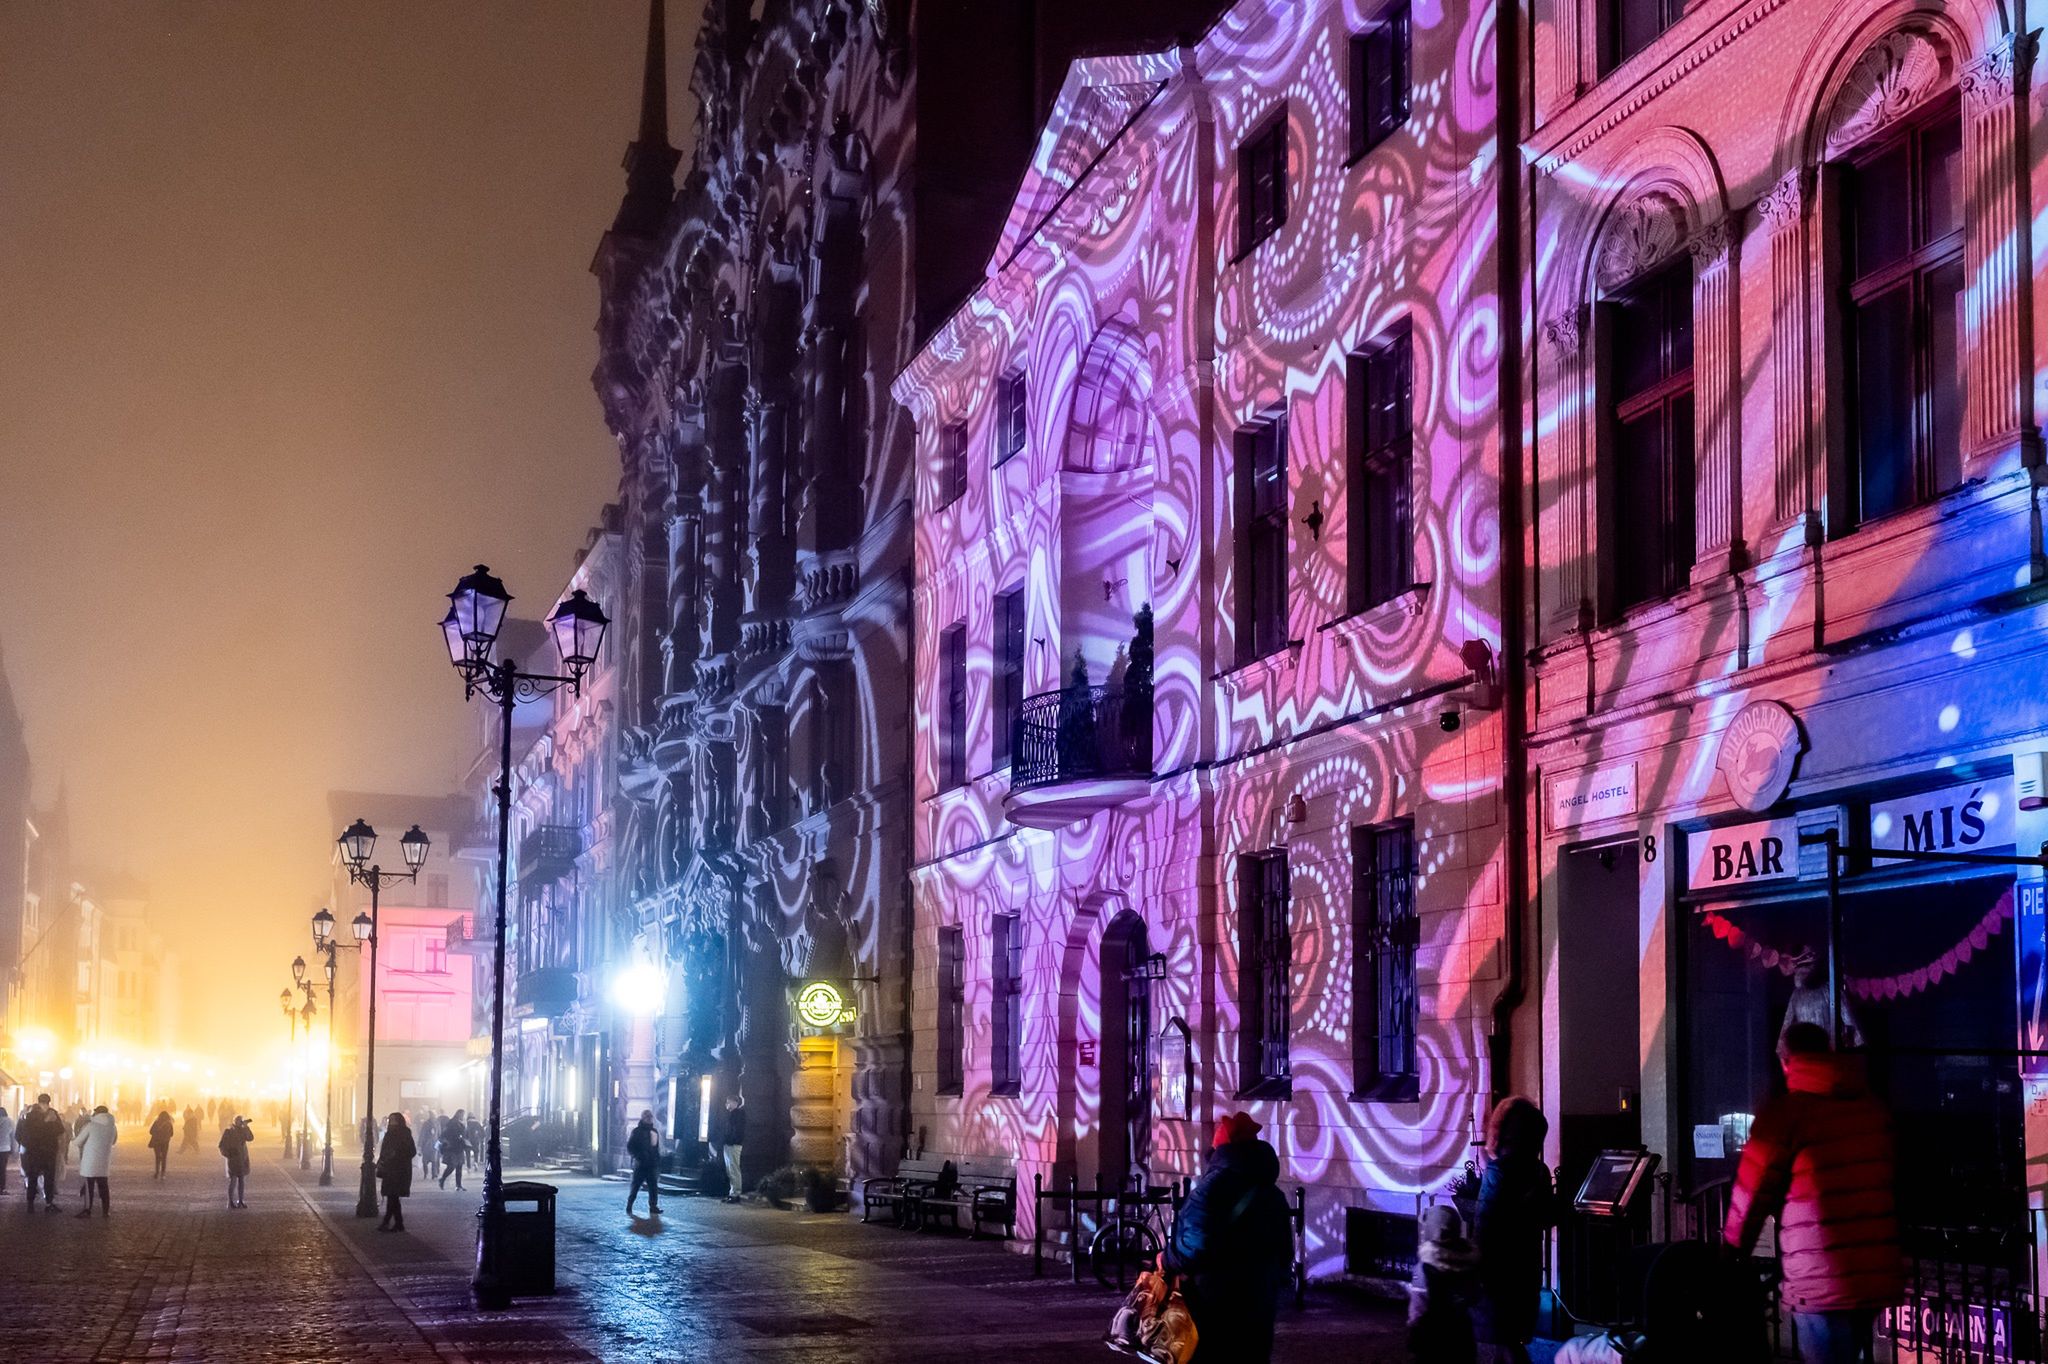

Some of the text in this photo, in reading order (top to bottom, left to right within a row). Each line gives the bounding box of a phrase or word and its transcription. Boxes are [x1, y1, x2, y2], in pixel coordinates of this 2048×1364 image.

[1559, 785, 1628, 809] ANGEL HOSTEL
[1712, 787, 1985, 881] BAR MIŚ
[1643, 835, 1656, 863] 8
